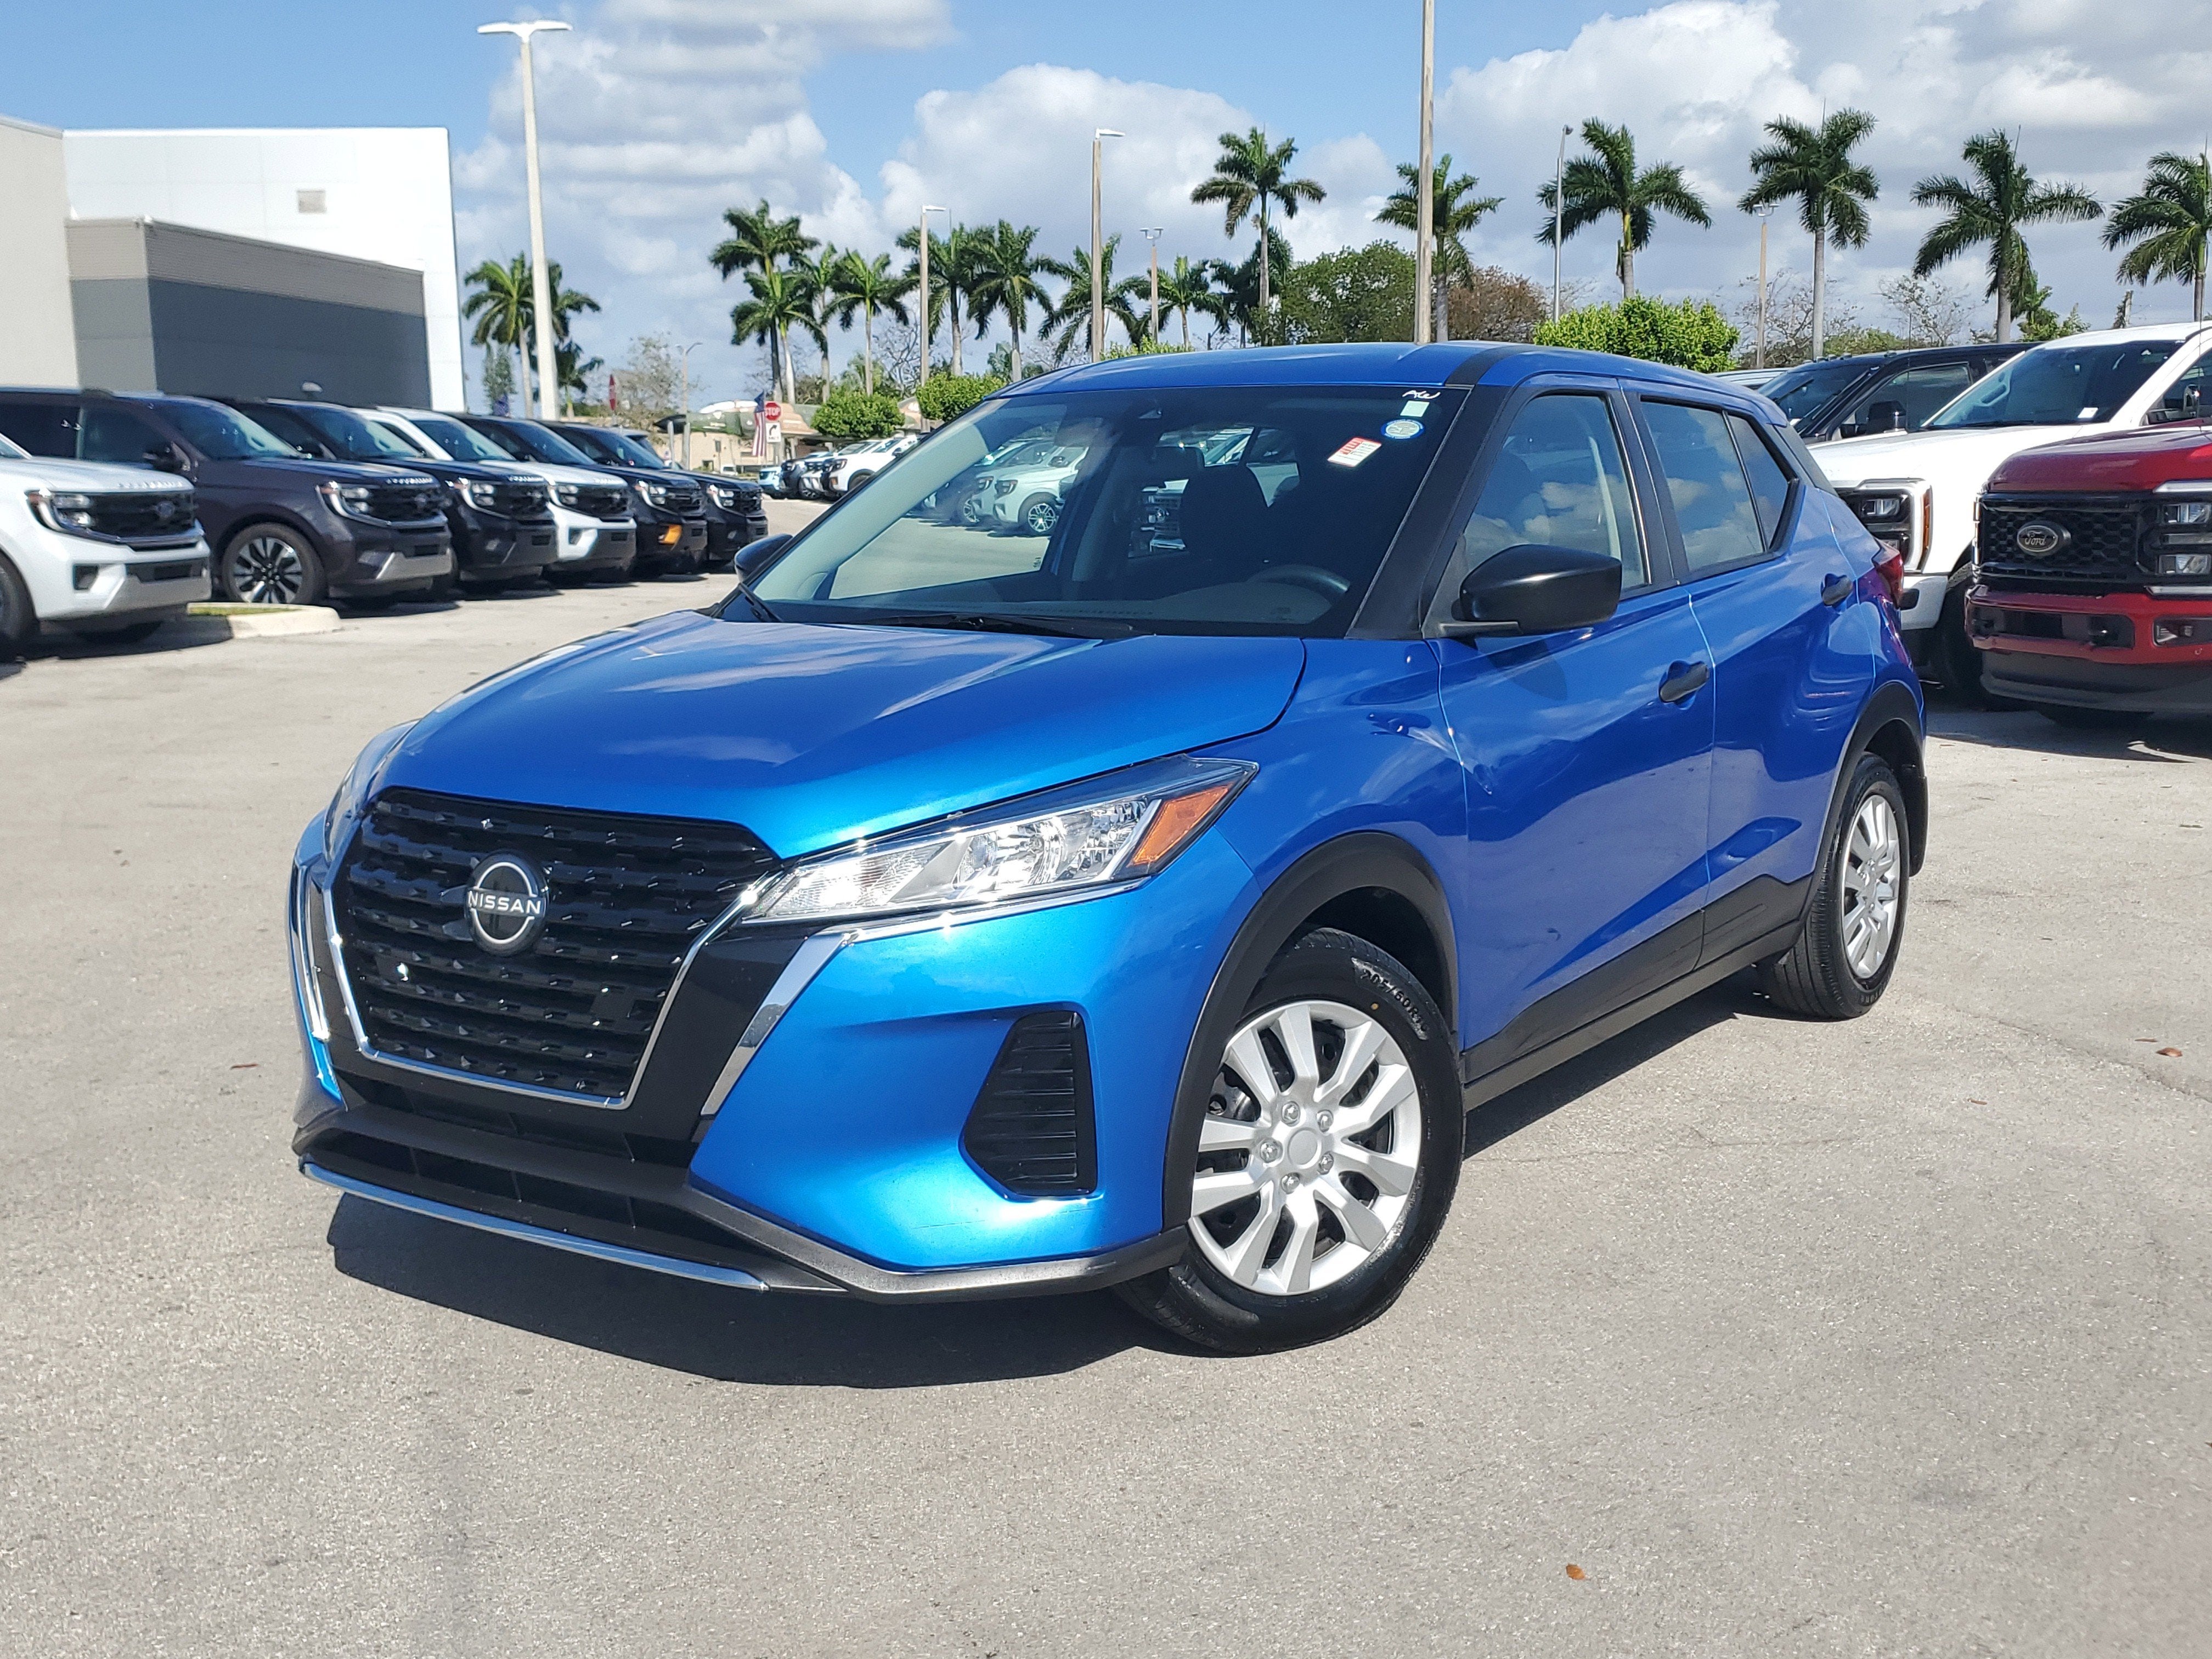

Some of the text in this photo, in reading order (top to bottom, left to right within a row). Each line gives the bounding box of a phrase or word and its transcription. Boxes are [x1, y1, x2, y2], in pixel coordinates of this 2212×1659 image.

[765, 407, 780, 416] STOP
[2024, 530, 2047, 546] Ford
[468, 890, 541, 915] NISSAN
